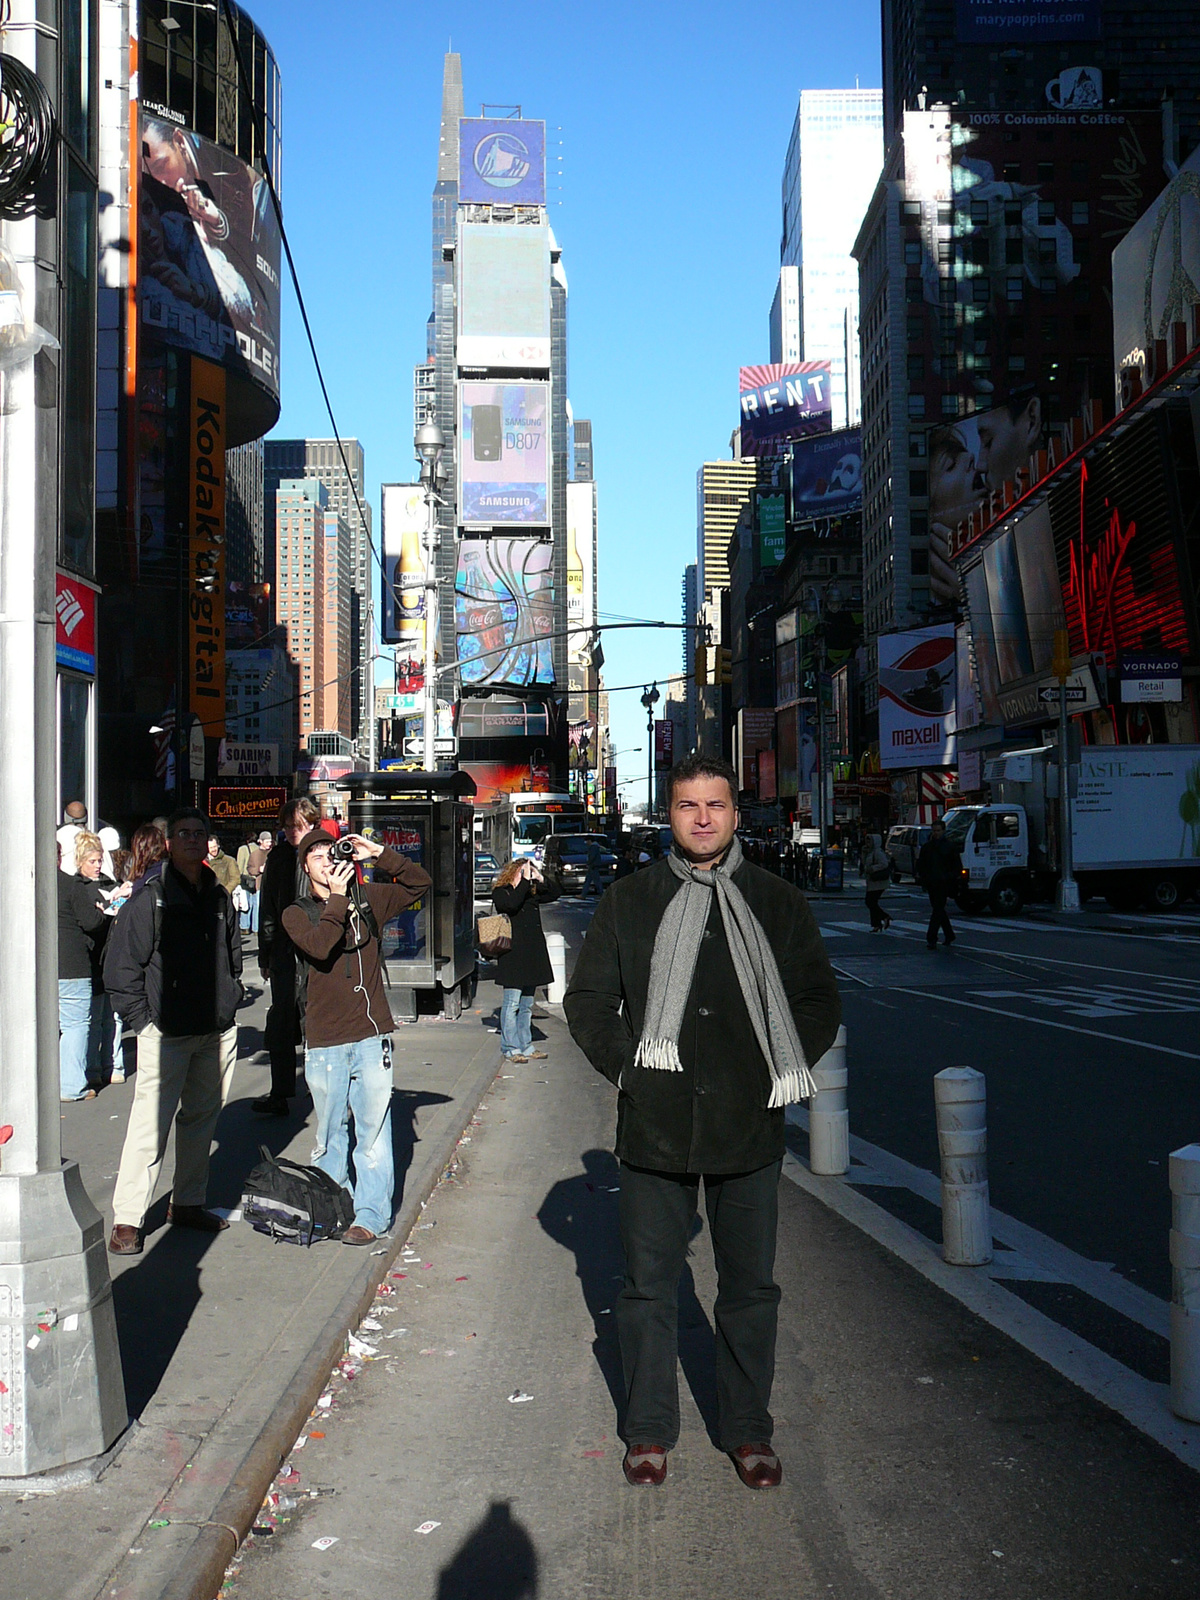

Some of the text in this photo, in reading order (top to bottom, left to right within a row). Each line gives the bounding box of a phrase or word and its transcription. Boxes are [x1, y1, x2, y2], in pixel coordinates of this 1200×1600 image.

[975, 12, 1085, 27] marypoppins.com
[969, 113, 1125, 125] 100% Colombian Coffee
[740, 374, 824, 421] RENT
[504, 417, 542, 427] SAMSUNG
[505, 432, 541, 450] D807
[479, 496, 531, 507] SAMSUNG
[190, 397, 221, 698] Kodak digital
[1122, 661, 1179, 672] VORNADO
[1138, 681, 1164, 691] Retail
[395, 696, 406, 707] 45
[663, 720, 672, 751] RENEW
[892, 722, 940, 747] maxell
[226, 748, 271, 762] SOARING
[238, 762, 258, 775] AND
[1077, 761, 1129, 778] TASTE
[215, 797, 280, 816] Chaperone
[382, 830, 421, 846] MEGA
